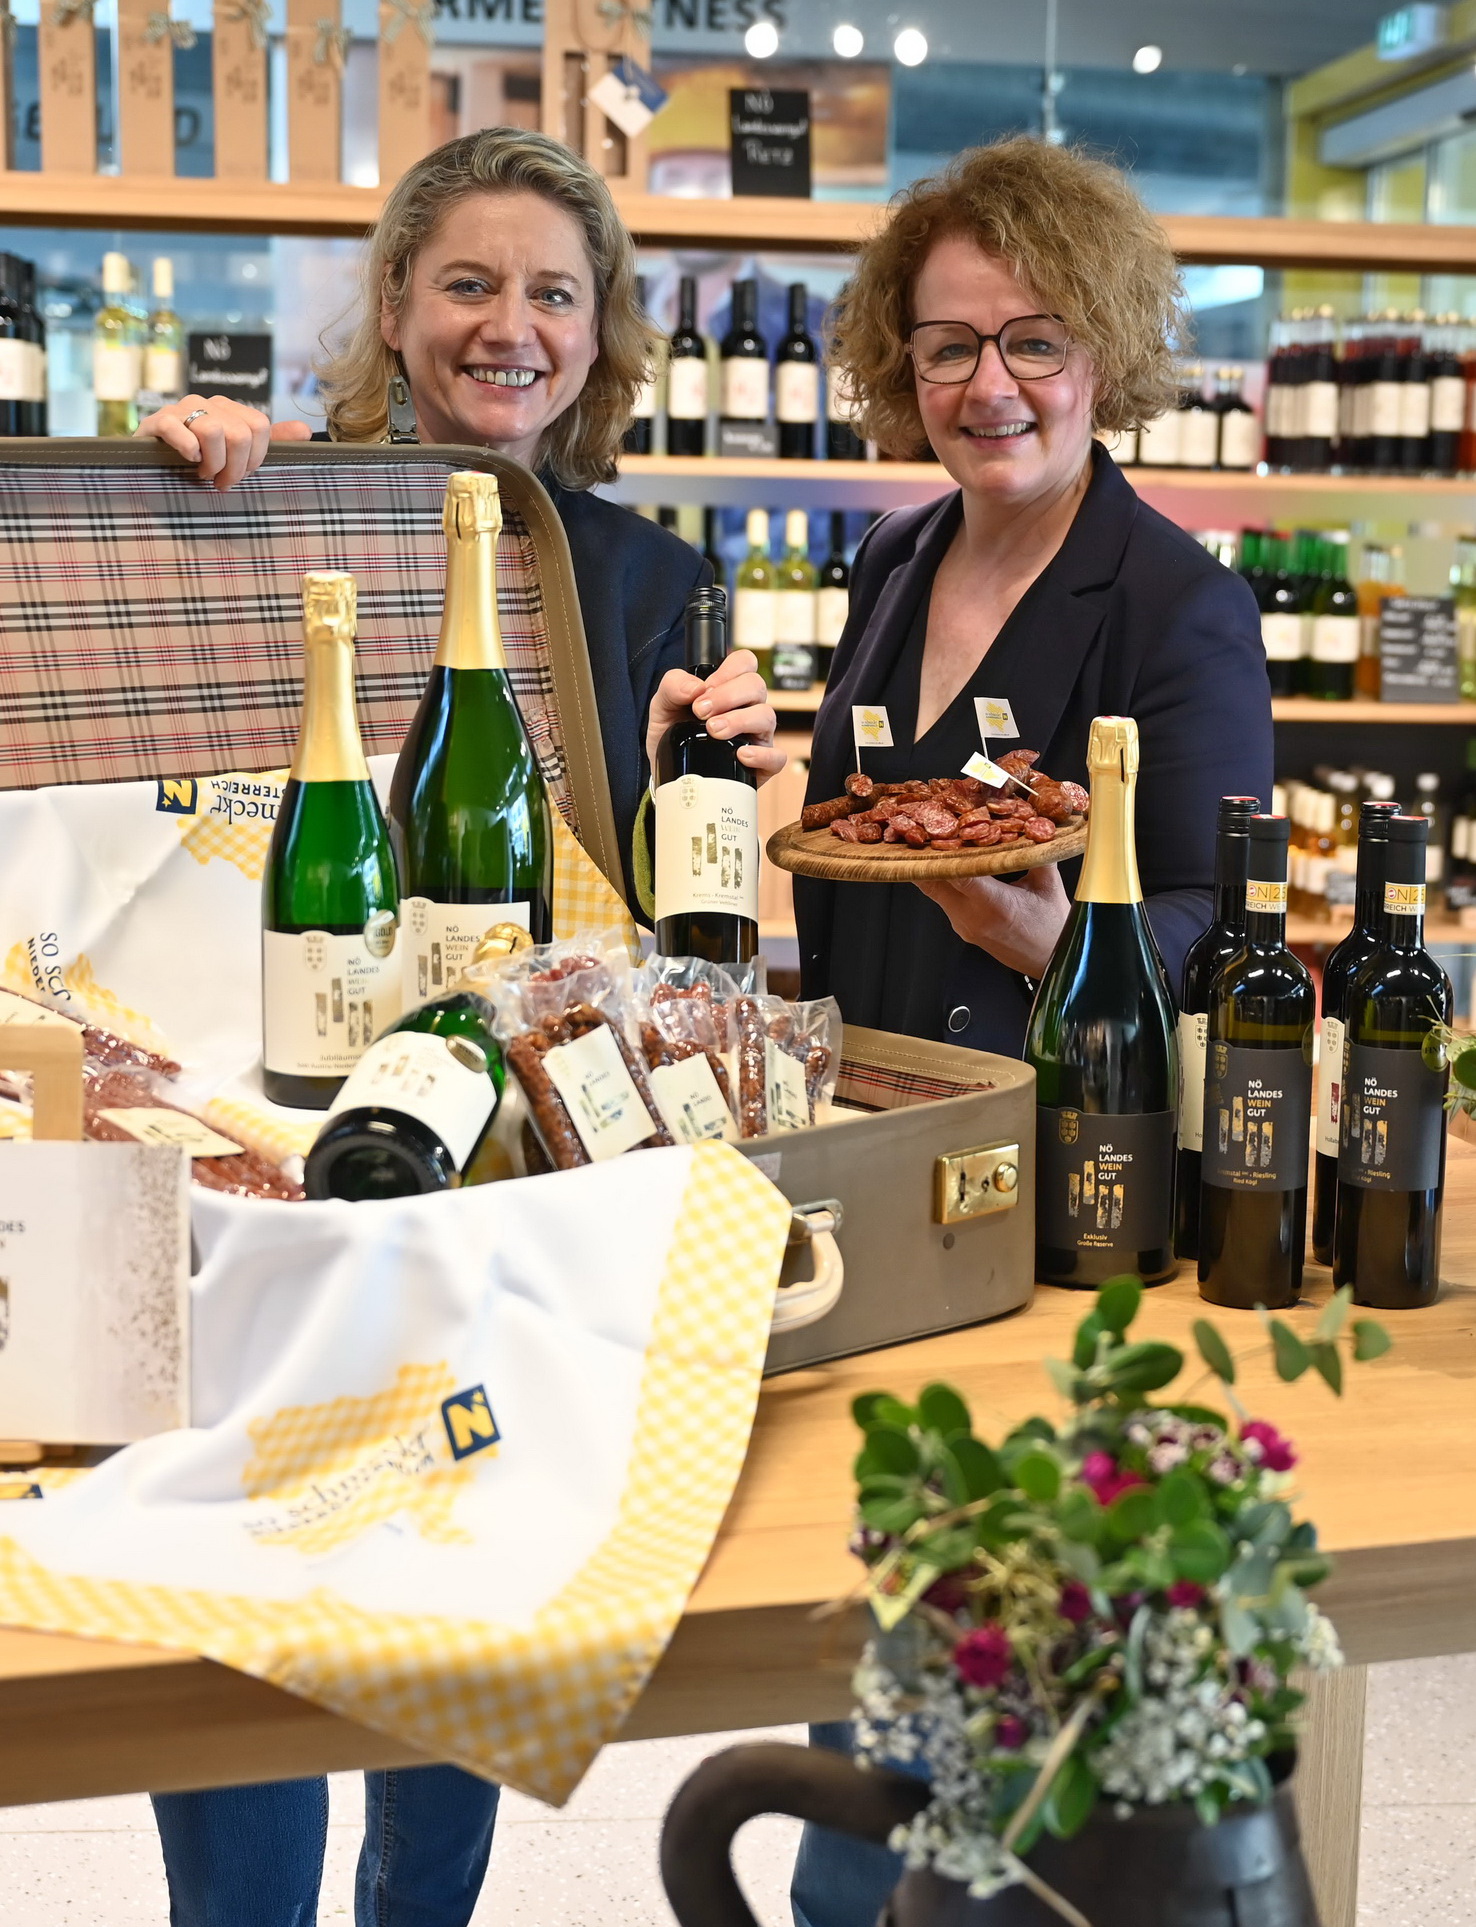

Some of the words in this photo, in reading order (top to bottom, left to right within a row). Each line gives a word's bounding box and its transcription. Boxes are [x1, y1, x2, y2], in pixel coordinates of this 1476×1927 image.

[211, 781, 286, 798] TERREICH
[721, 807, 734, 815] NÖ
[721, 816, 749, 828] LANDES
[721, 833, 737, 842] GUT
[446, 925, 460, 933] NÖ
[347, 986, 365, 995] GUT
[1248, 1079, 1263, 1089] NÖ
[1364, 1077, 1378, 1087] NÖ
[1247, 1089, 1283, 1099] LANDES
[1363, 1086, 1398, 1098] LANDES
[1247, 1099, 1272, 1108] WEIN
[1363, 1096, 1386, 1107] WEIN
[1247, 1108, 1267, 1117] GUT
[1363, 1105, 1381, 1115] GUT
[1099, 1143, 1113, 1153] NÖ
[1098, 1153, 1133, 1162] LANDES
[1098, 1162, 1123, 1171] WEIN
[1098, 1172, 1117, 1180] GUT
[1083, 1233, 1108, 1241] Exklusiv
